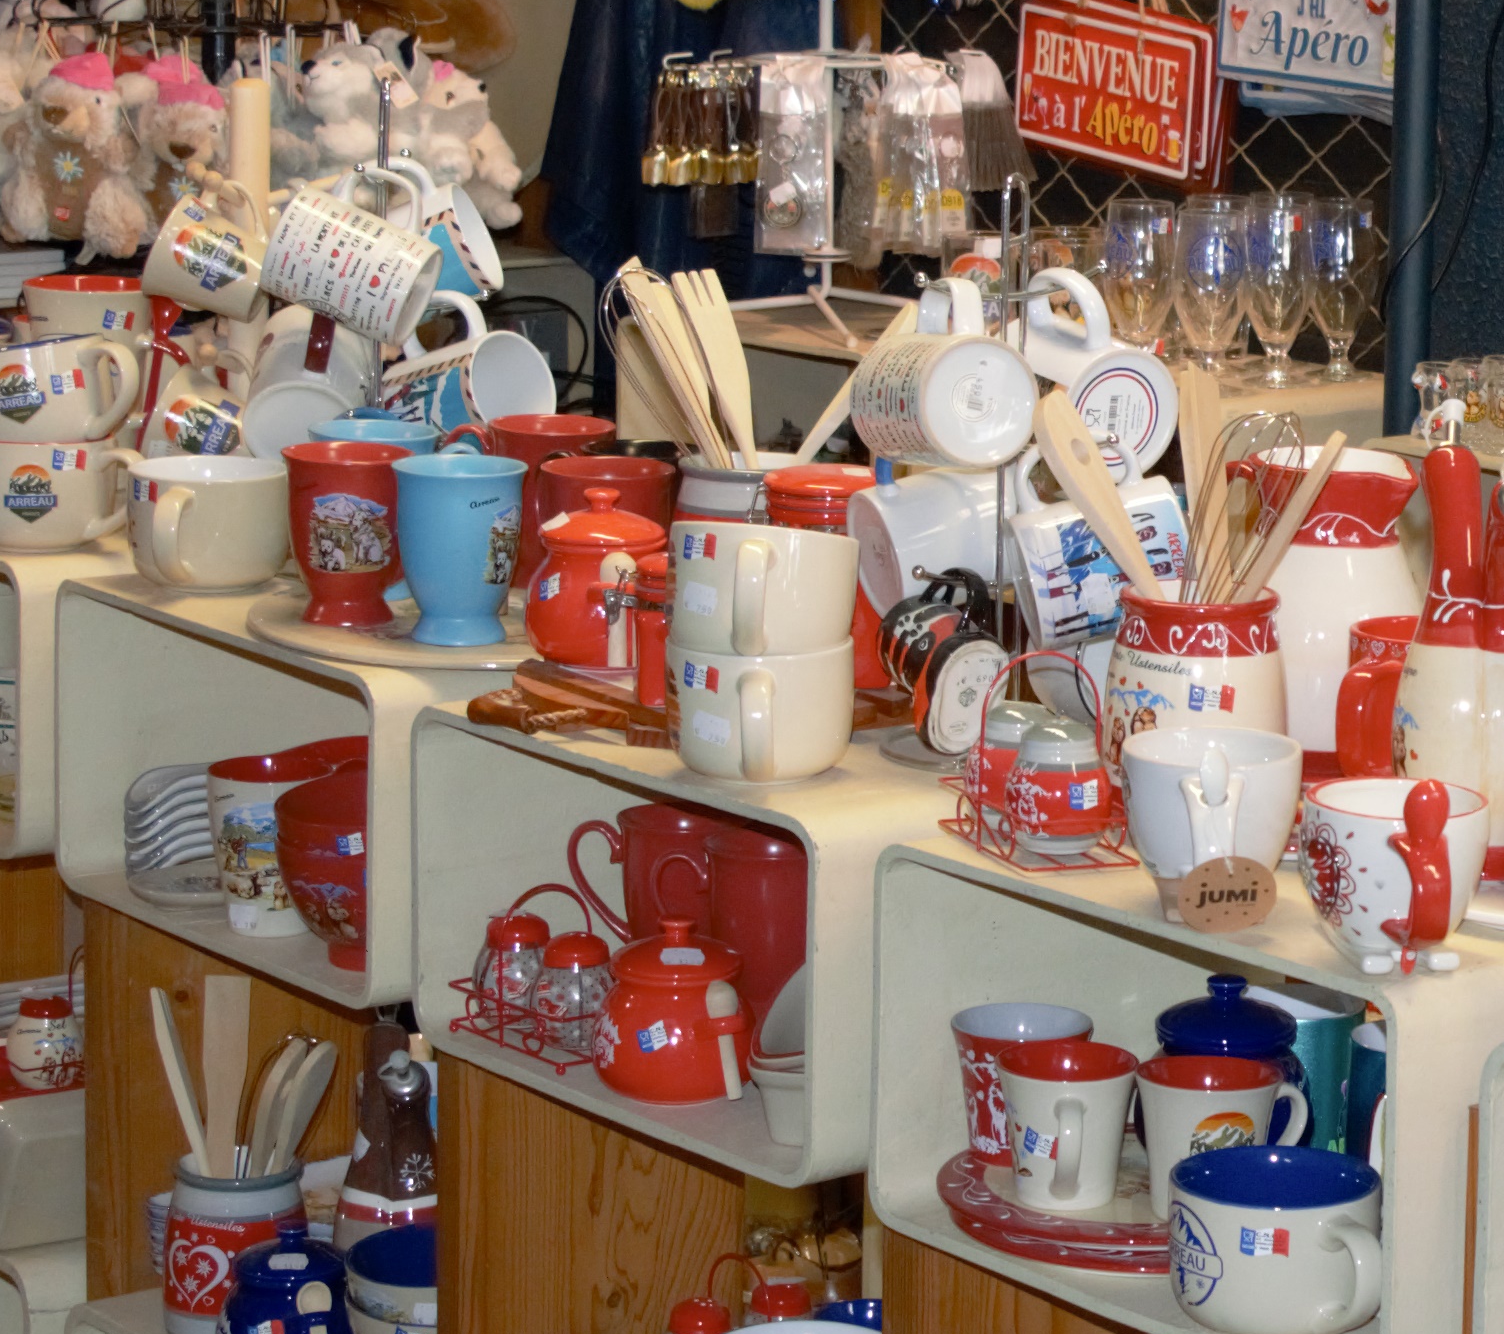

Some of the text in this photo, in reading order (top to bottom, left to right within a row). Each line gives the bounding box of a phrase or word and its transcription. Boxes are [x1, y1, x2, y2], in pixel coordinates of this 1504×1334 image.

[1249, 9, 1370, 71] Apéro
[1033, 30, 1180, 110] BIENVENUE
[202, 234, 240, 290] ARREAU
[7, 496, 55, 507] ARREAU
[1127, 651, 1194, 676] Ustensiles
